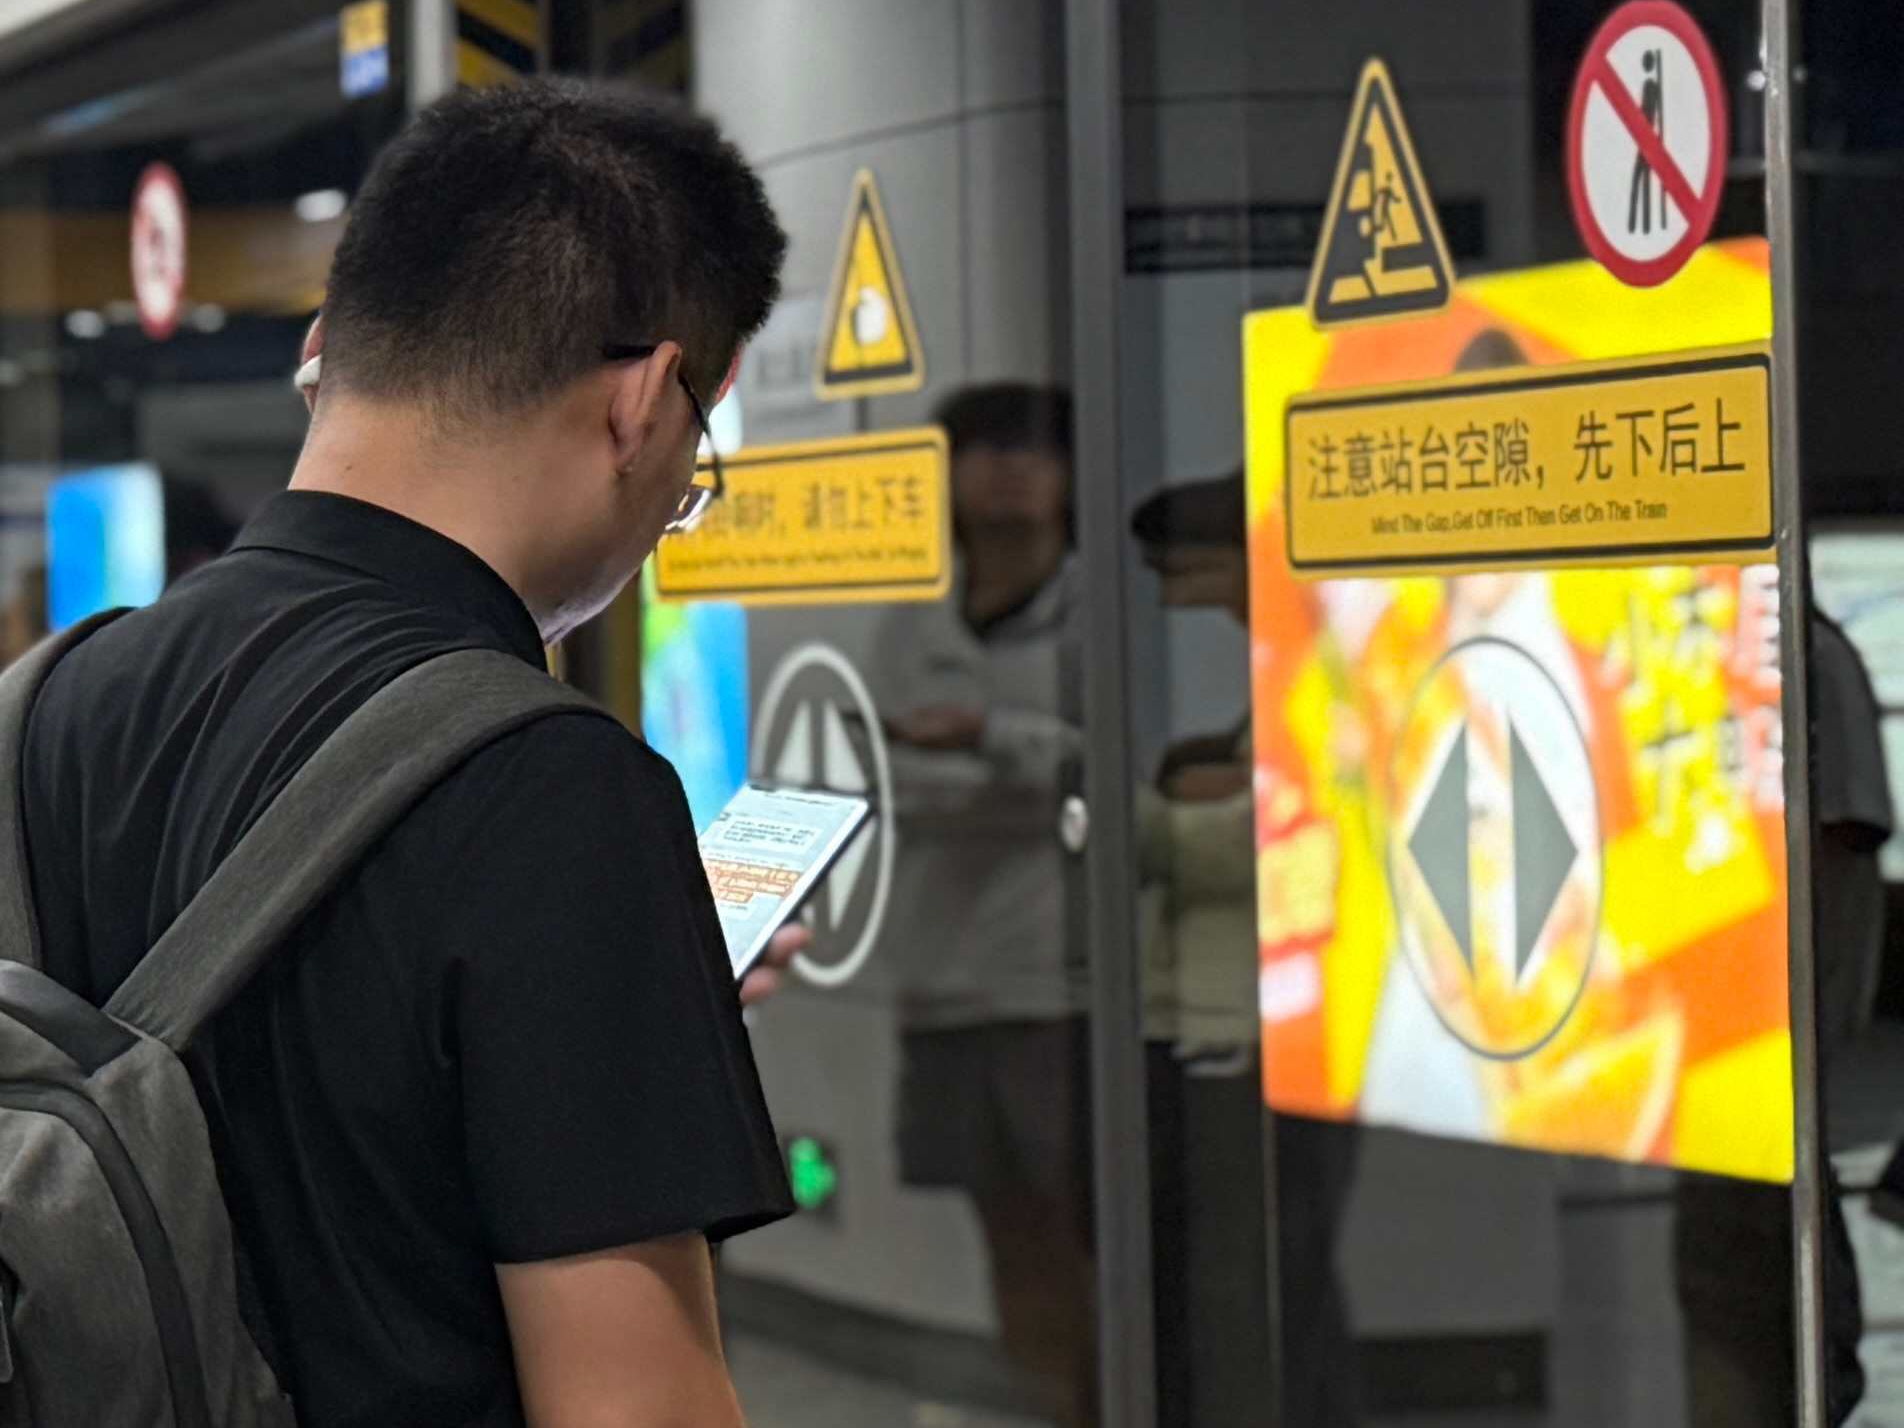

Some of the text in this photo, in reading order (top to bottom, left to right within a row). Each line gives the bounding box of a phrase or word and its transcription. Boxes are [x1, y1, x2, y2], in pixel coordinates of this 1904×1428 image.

[1307, 397, 1746, 500] 注意站台空隙，先下后上
[1371, 515, 1399, 535] Mind
[1401, 513, 1423, 533] The
[1476, 508, 1496, 530] Off
[1496, 507, 1523, 528] First
[1525, 505, 1557, 526] Then
[1558, 503, 1582, 525] Get
[1583, 501, 1604, 523] On
[1606, 500, 1632, 521] The
[1633, 498, 1669, 520] Train
